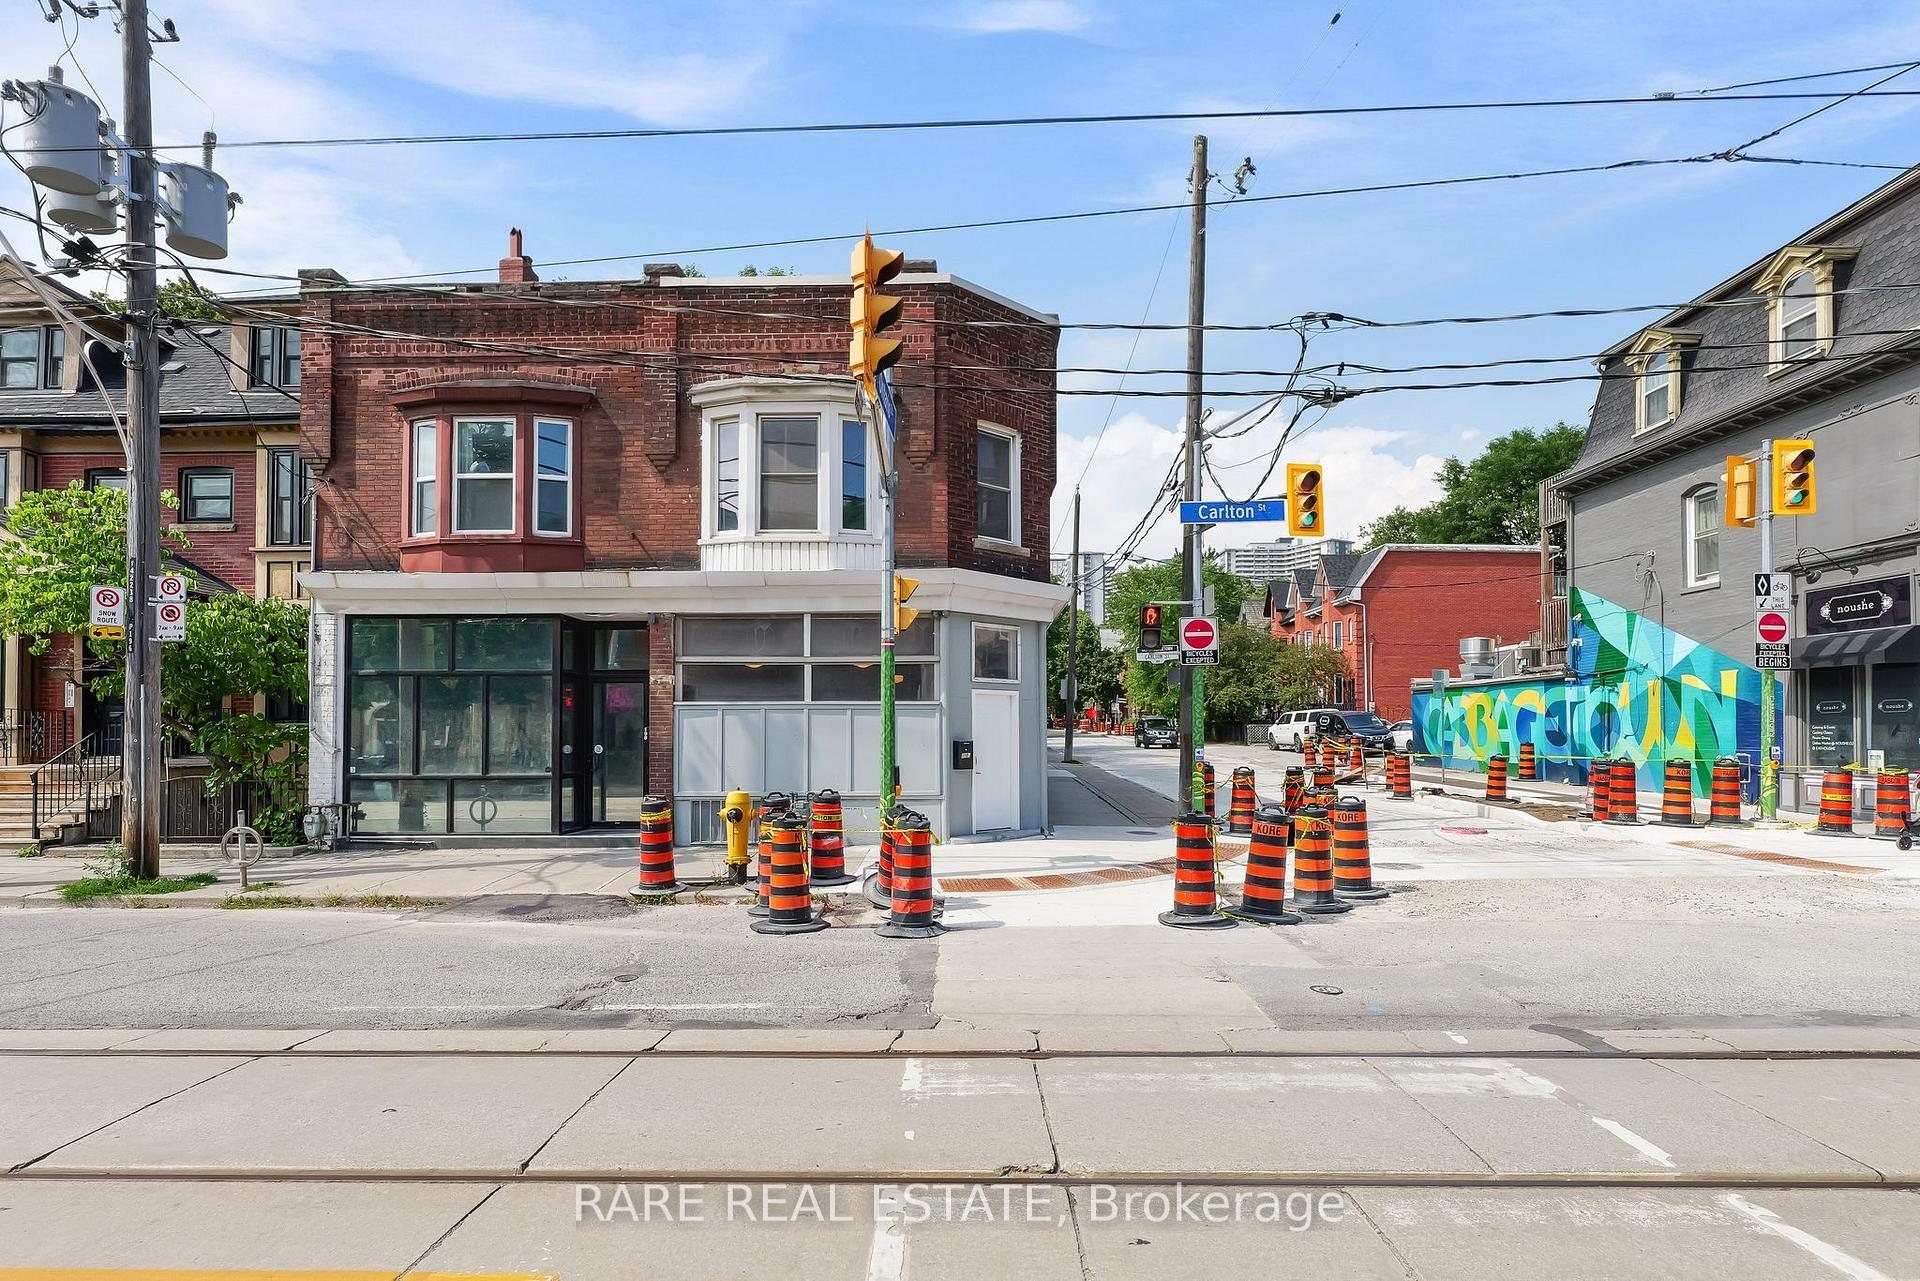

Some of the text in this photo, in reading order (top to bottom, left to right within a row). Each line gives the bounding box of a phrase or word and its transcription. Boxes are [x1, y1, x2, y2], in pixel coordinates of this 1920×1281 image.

[1198, 503, 1266, 519] Carlton St
[1837, 598, 1874, 613] noushe
[97, 616, 117, 624] ROUTE
[1758, 657, 1788, 667] BEGINS
[1422, 669, 1738, 796] CABBAGETOWN
[1336, 812, 1359, 822] KORE
[1256, 823, 1281, 836] KORE
